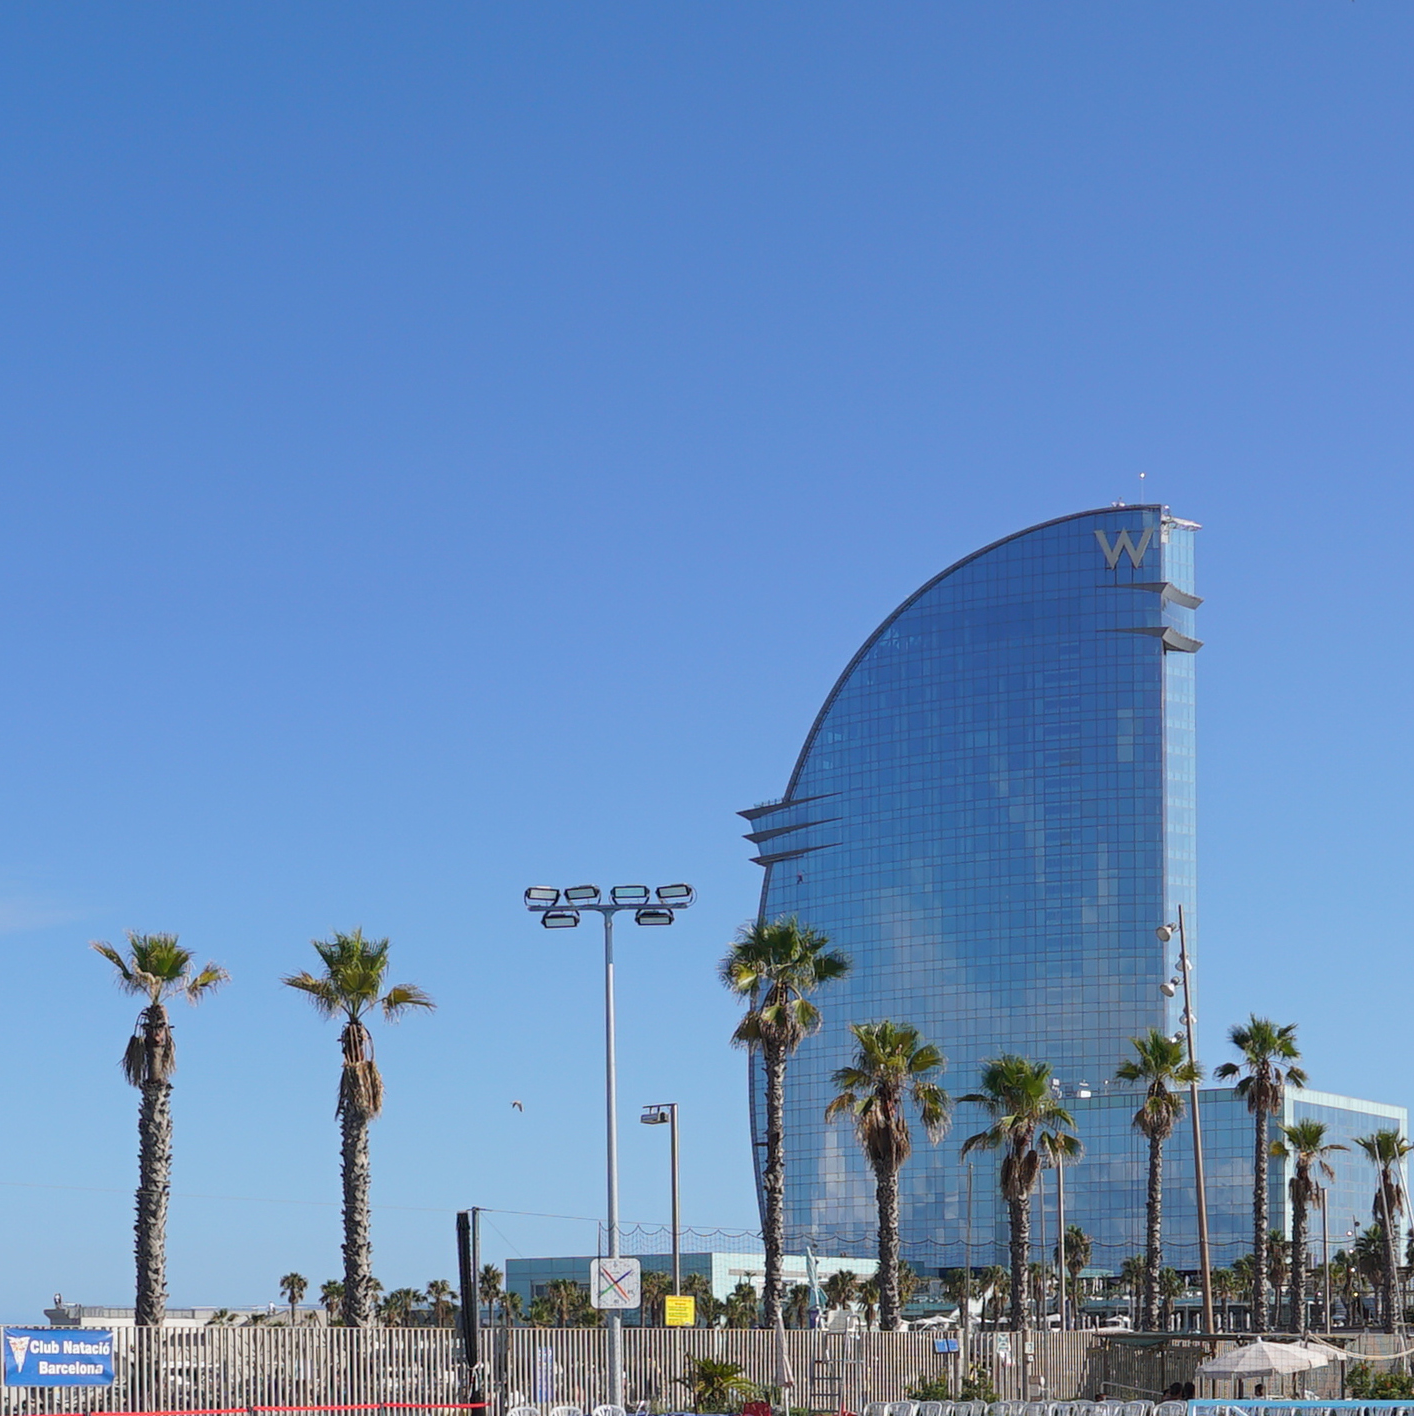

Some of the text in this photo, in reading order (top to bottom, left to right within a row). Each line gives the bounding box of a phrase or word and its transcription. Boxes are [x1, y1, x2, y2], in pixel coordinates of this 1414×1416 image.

[1094, 527, 1153, 570] W
[29, 1339, 111, 1355] Club Natació
[38, 1360, 104, 1376] Barcelona
